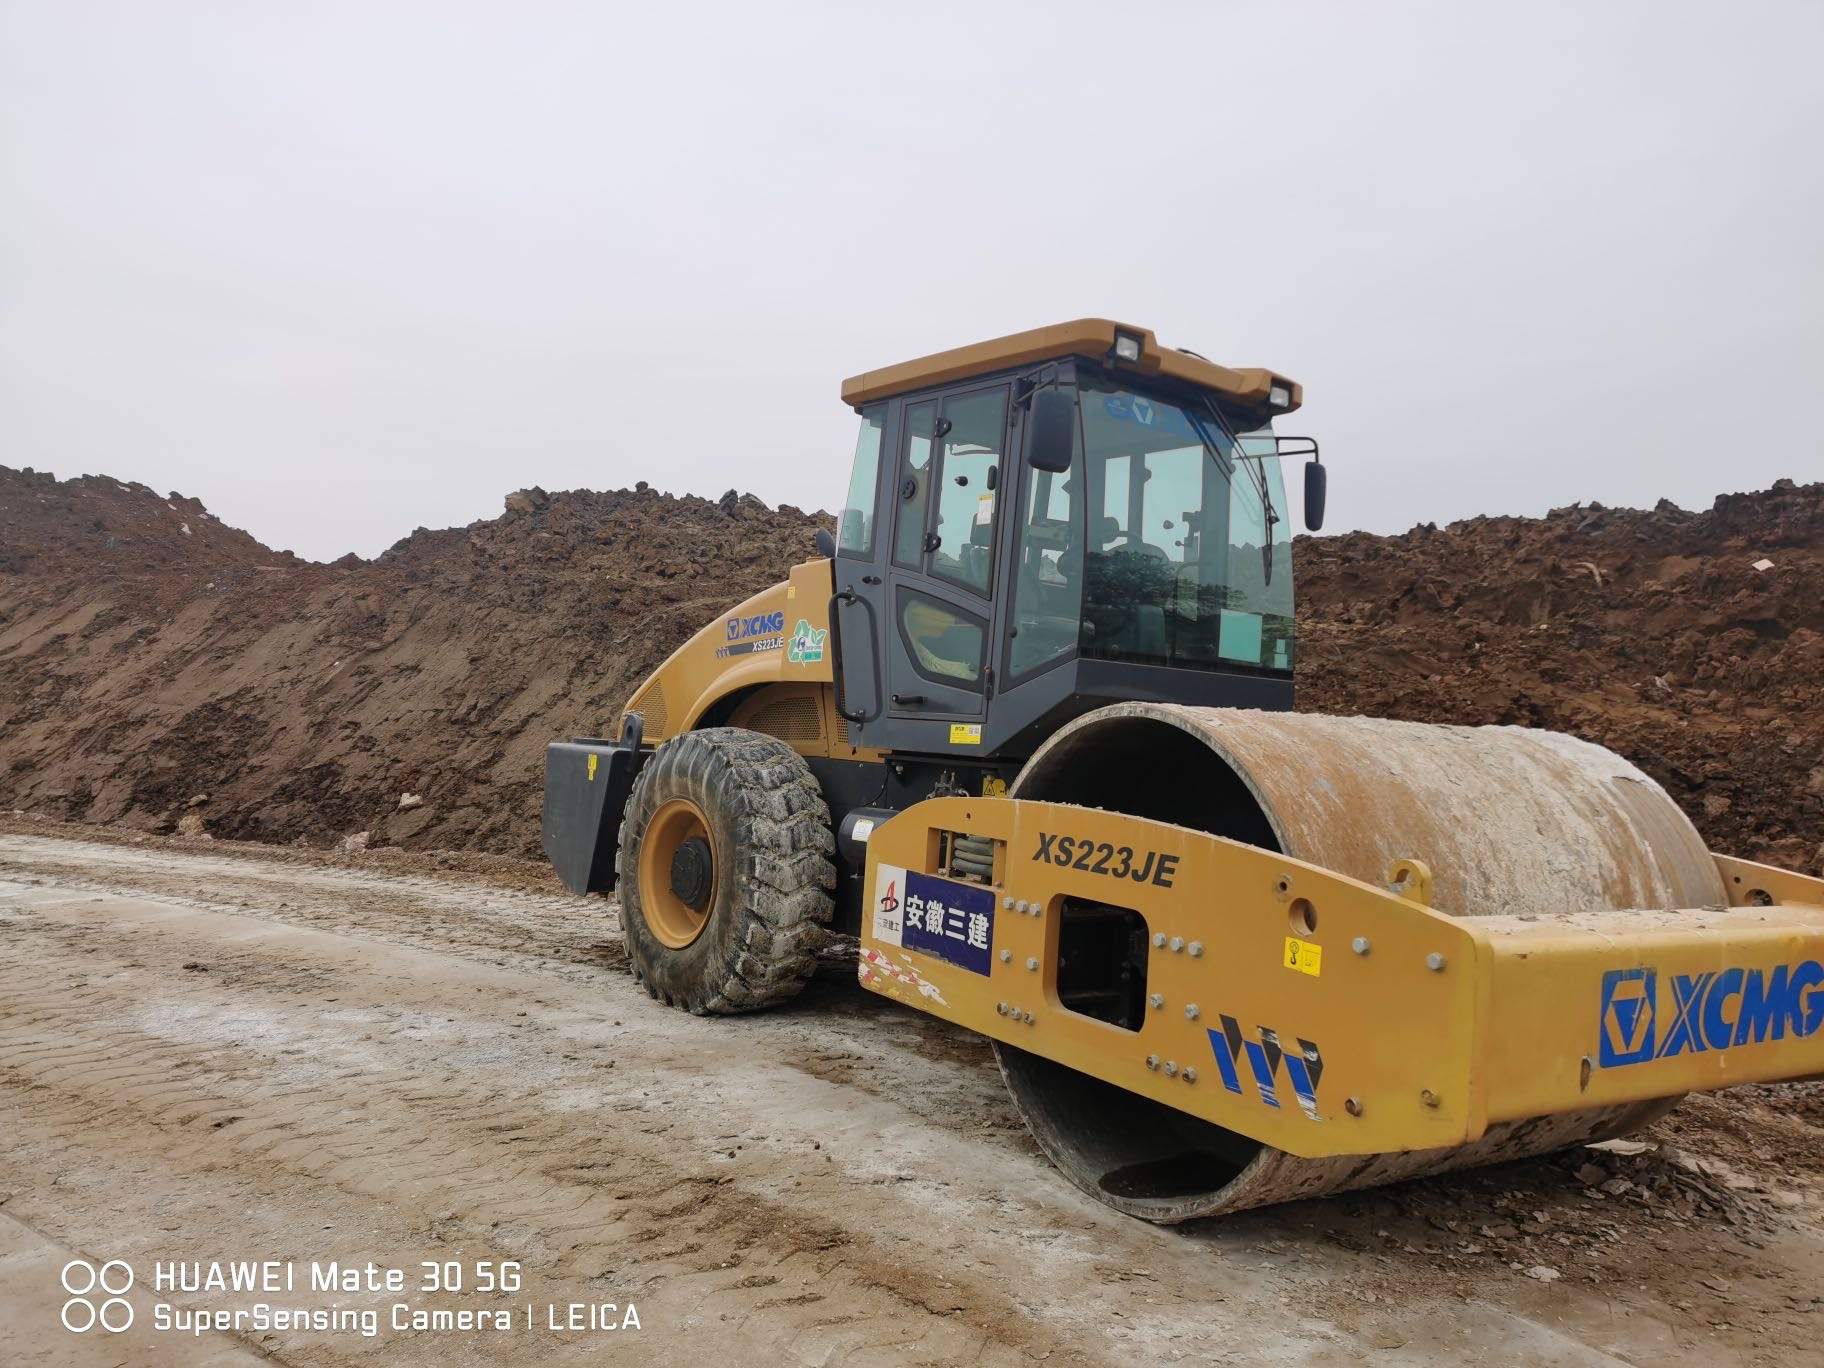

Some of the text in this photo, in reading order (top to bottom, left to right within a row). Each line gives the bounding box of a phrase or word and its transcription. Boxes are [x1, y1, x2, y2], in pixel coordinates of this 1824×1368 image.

[740, 611, 784, 638] XCMG
[752, 637, 784, 653] XS223JE
[1032, 832, 1180, 888] XS223JE
[905, 894, 990, 950] 安徽三建
[1655, 960, 1824, 1059] XCMG
